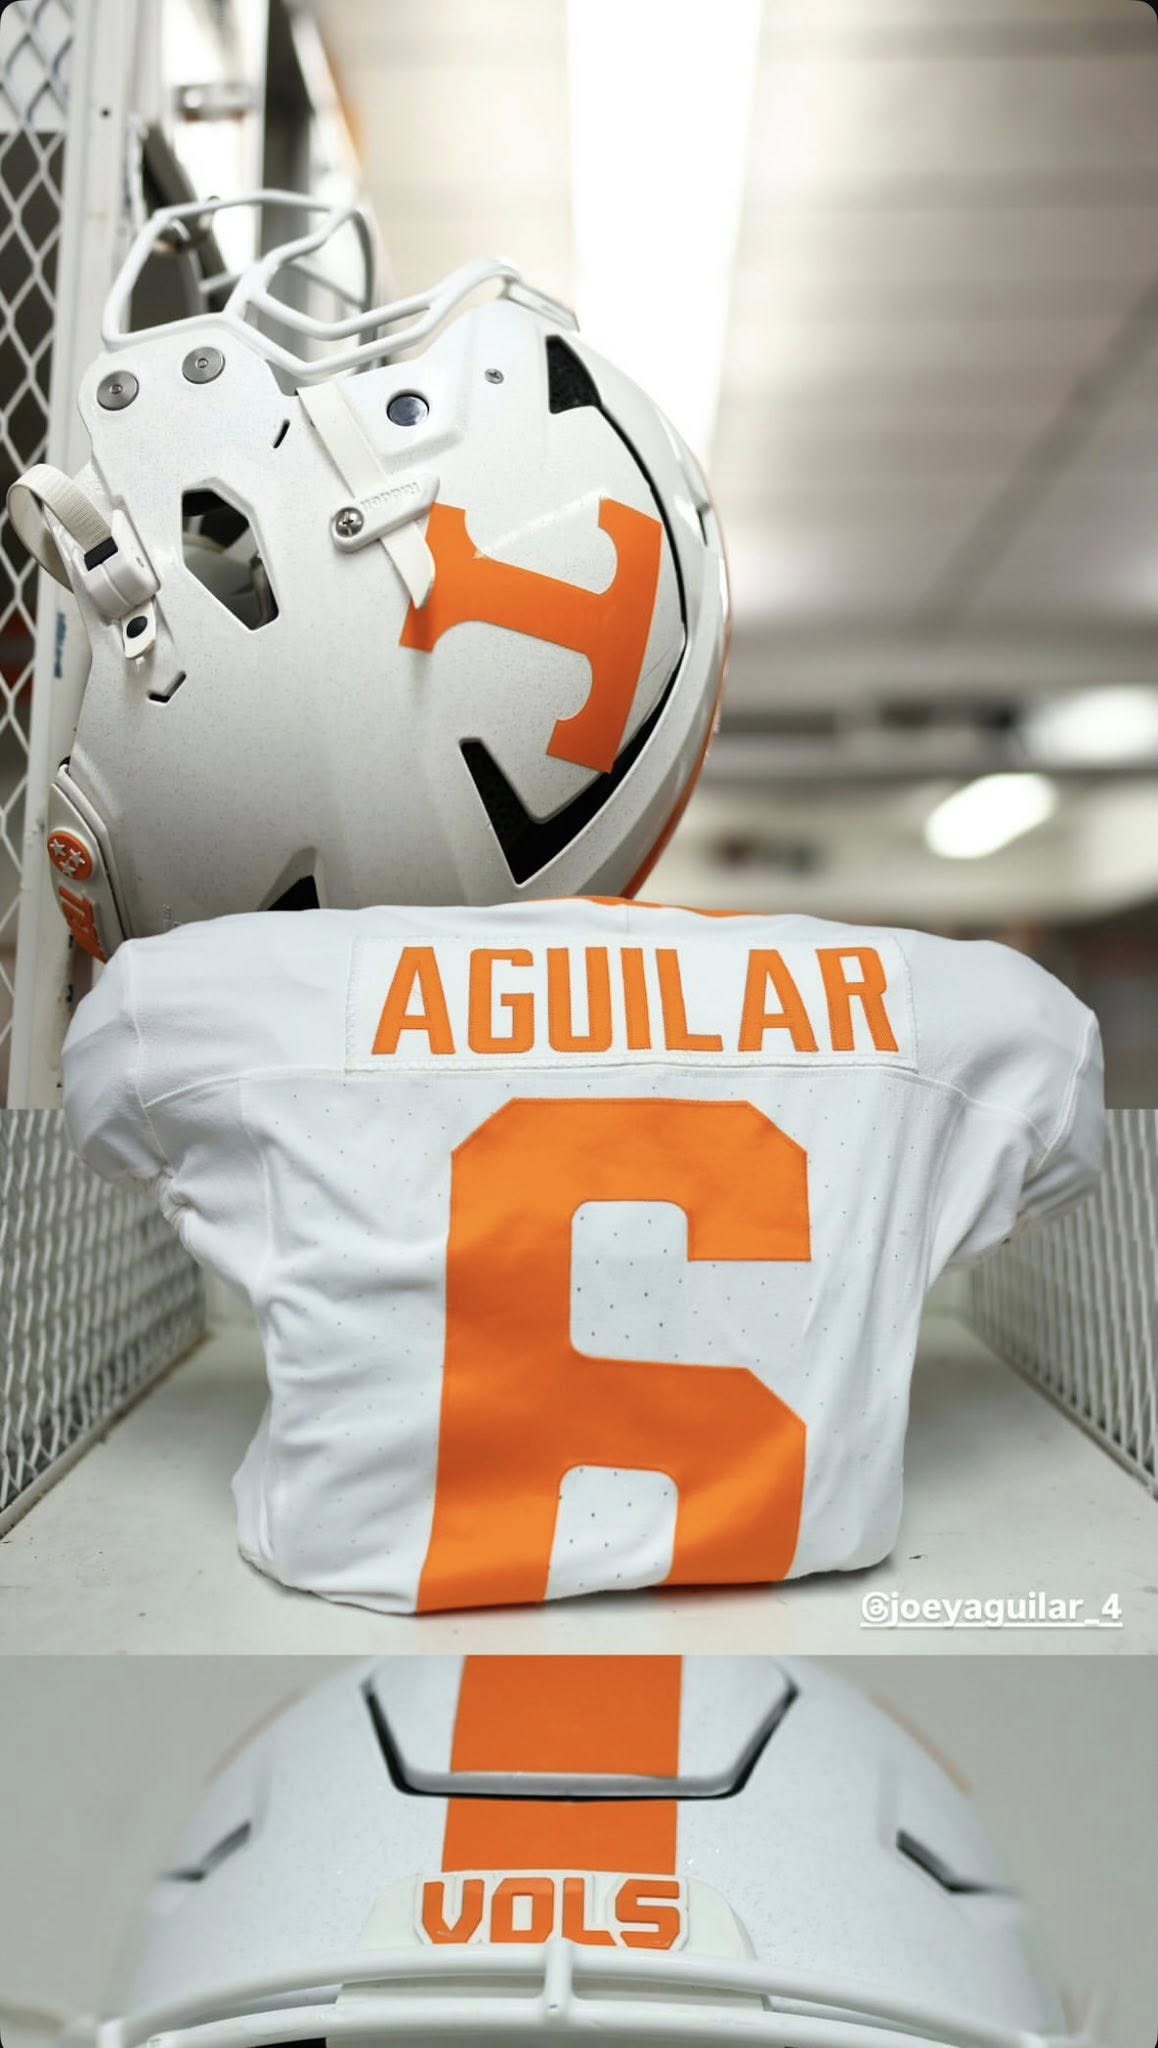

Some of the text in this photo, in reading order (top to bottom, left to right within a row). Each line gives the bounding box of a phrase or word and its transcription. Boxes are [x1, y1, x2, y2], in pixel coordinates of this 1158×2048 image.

[399, 496, 662, 773] T
[371, 946, 899, 1055] AGUILAR
[416, 1096, 812, 1616] 6
[421, 1876, 681, 1951] VOLS
